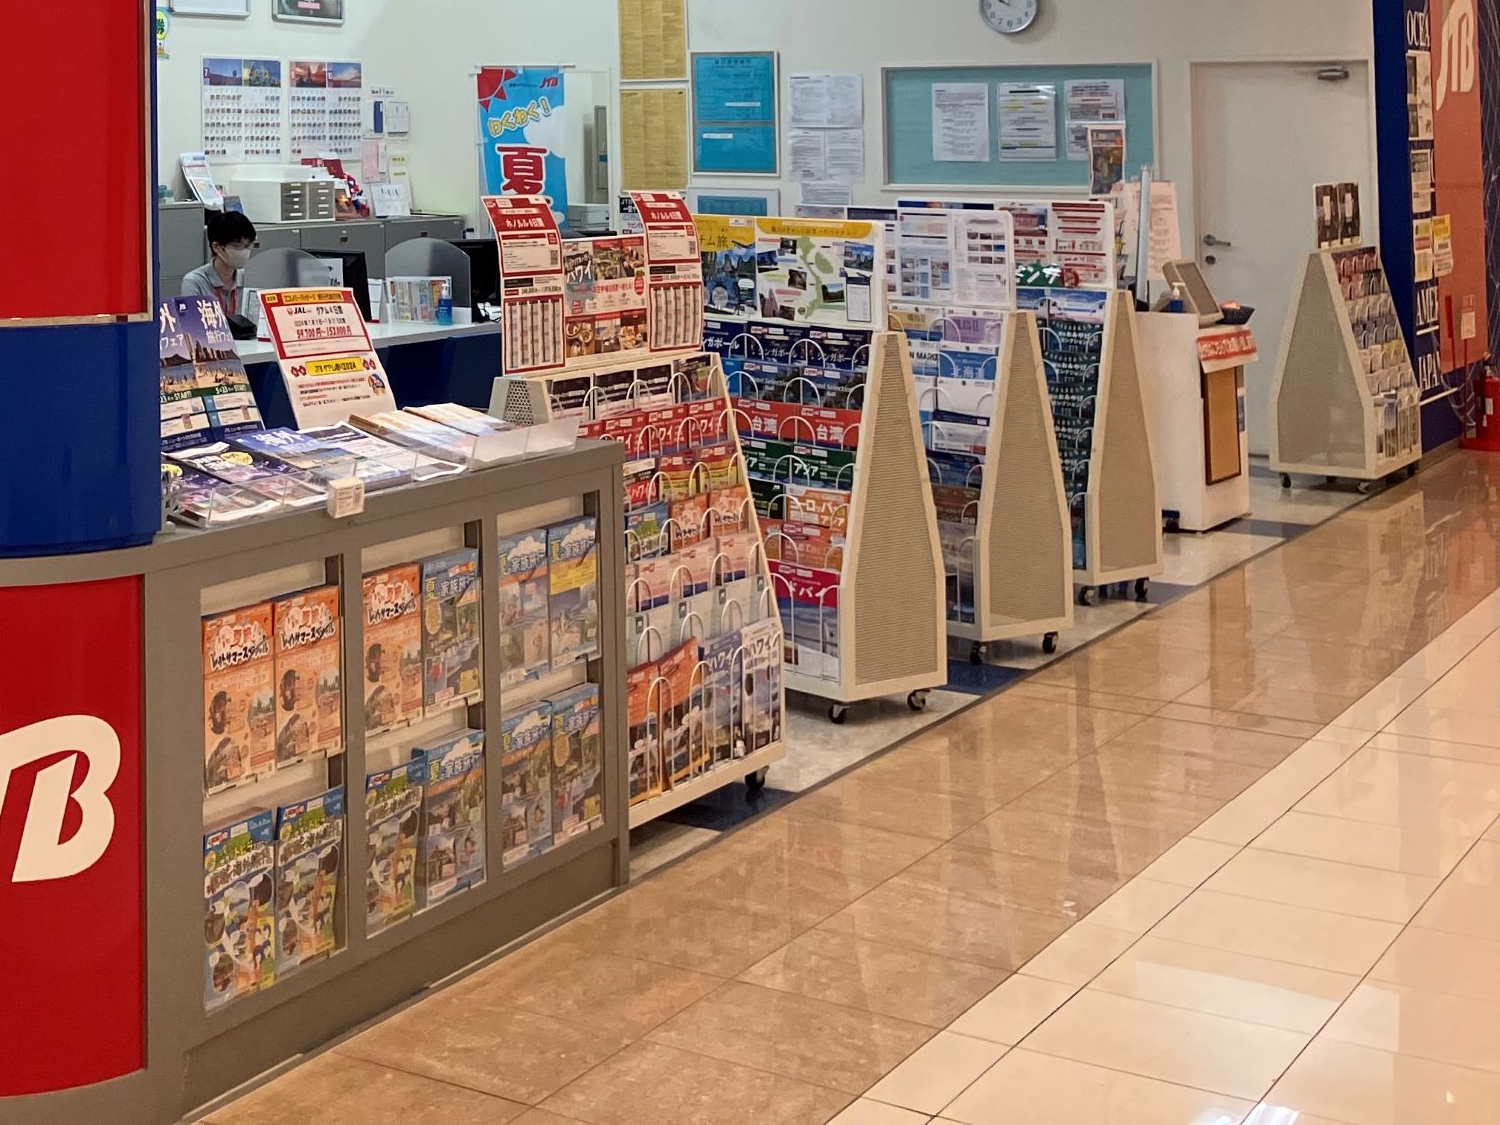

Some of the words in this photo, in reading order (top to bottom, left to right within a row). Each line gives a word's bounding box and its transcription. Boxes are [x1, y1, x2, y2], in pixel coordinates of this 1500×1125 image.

[540, 76, 559, 89] JTB
[495, 143, 548, 195] 夏
[293, 306, 307, 315] JAL
[751, 415, 779, 434] 台湾
[816, 424, 845, 443] 台湾
